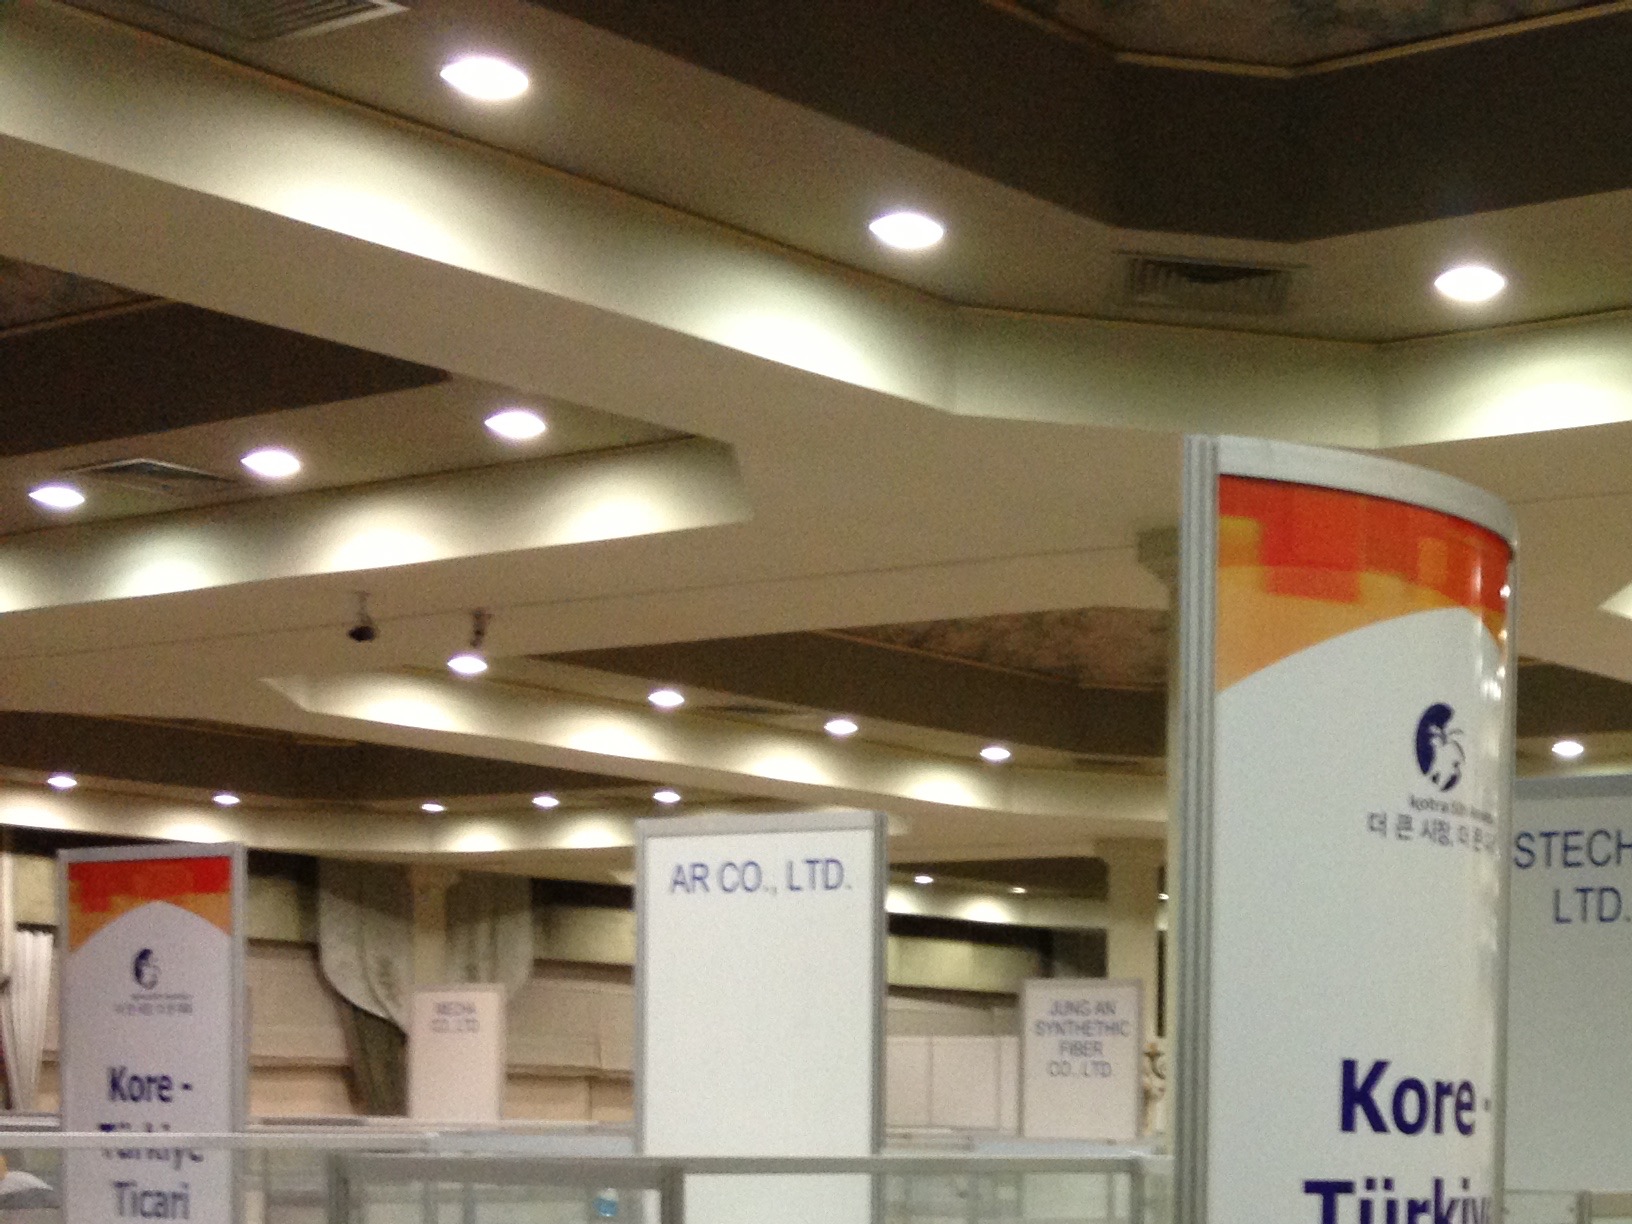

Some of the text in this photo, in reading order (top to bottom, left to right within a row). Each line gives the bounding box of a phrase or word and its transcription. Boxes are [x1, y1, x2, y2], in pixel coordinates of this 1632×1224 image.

[670, 858, 852, 897] AR CO., LTD.
[1552, 886, 1631, 924] LTD.
[108, 1066, 173, 1103] Kore
[112, 1179, 190, 1220] Ticari
